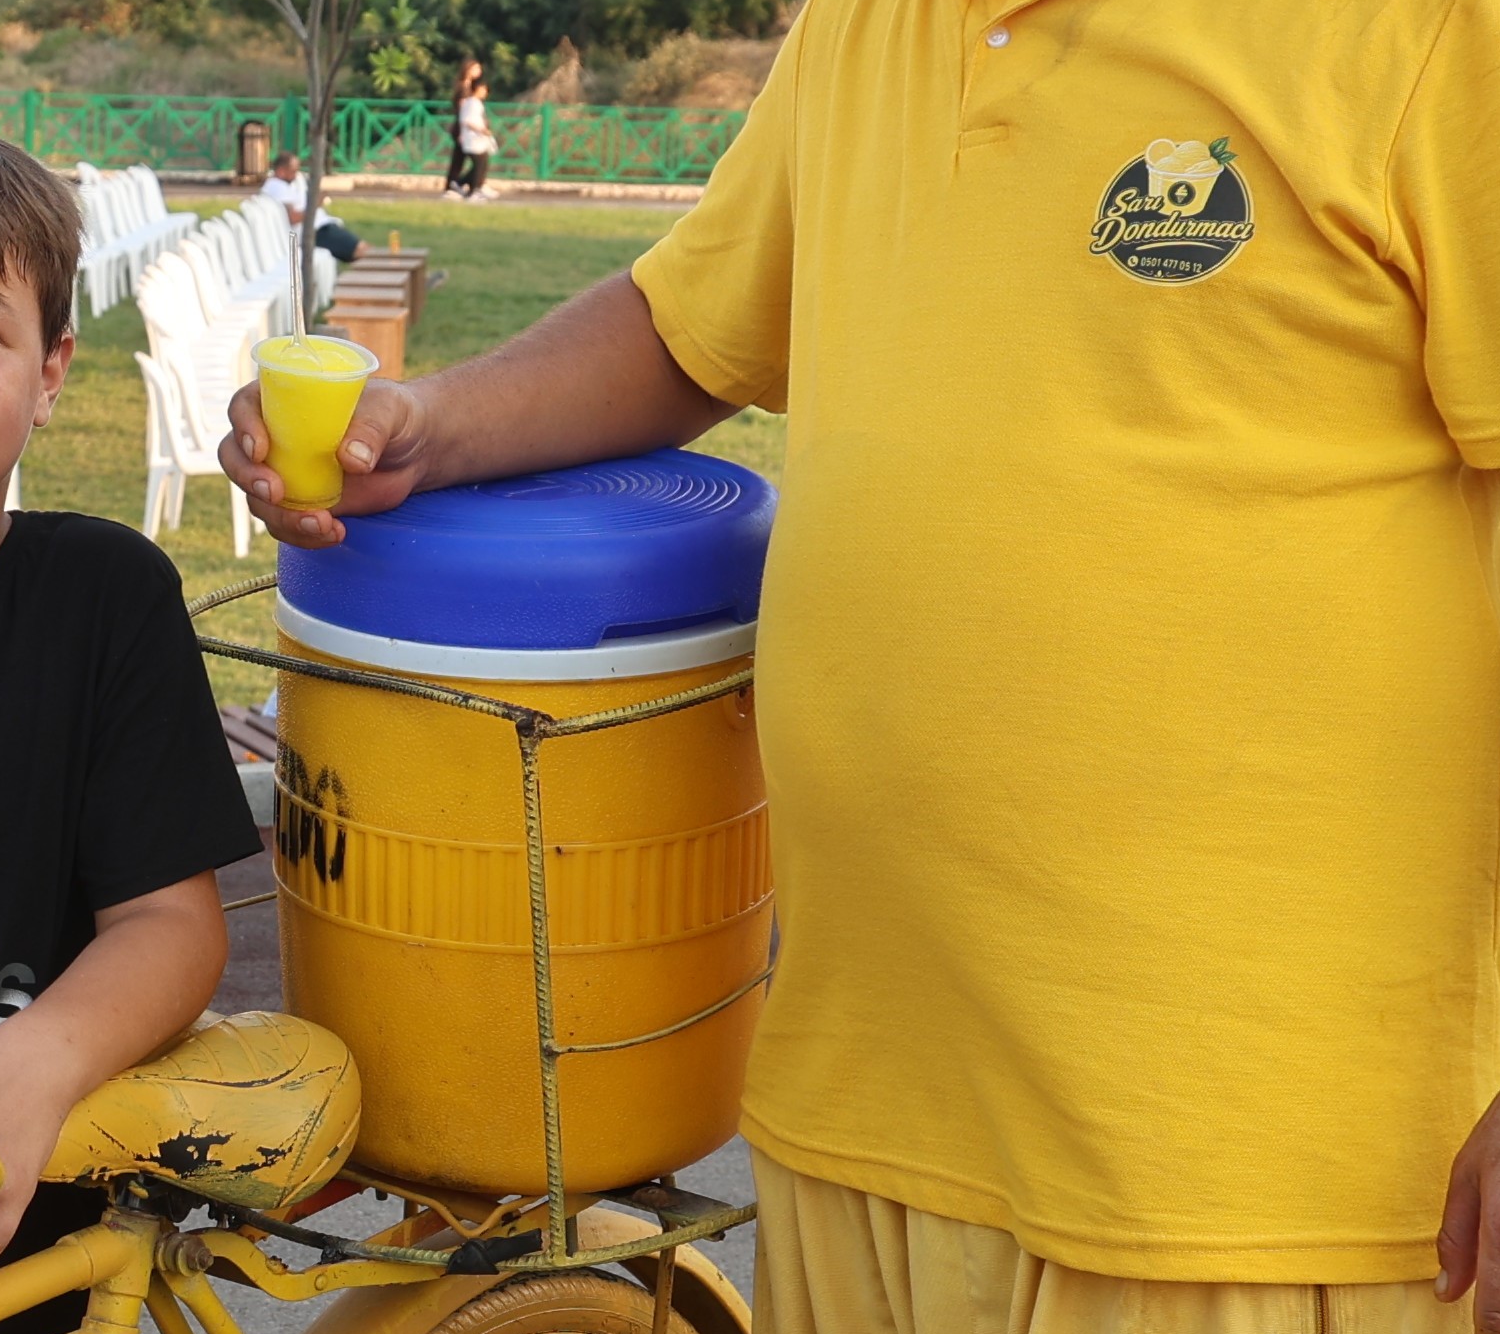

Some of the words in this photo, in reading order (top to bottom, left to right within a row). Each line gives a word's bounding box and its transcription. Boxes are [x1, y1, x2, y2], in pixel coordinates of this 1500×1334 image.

[1107, 188, 1164, 217] Sarı
[1090, 210, 1254, 255] Dondurmacı
[1140, 257, 1161, 267] 0501
[1163, 258, 1178, 269] 477
[1193, 263, 1202, 273] 12
